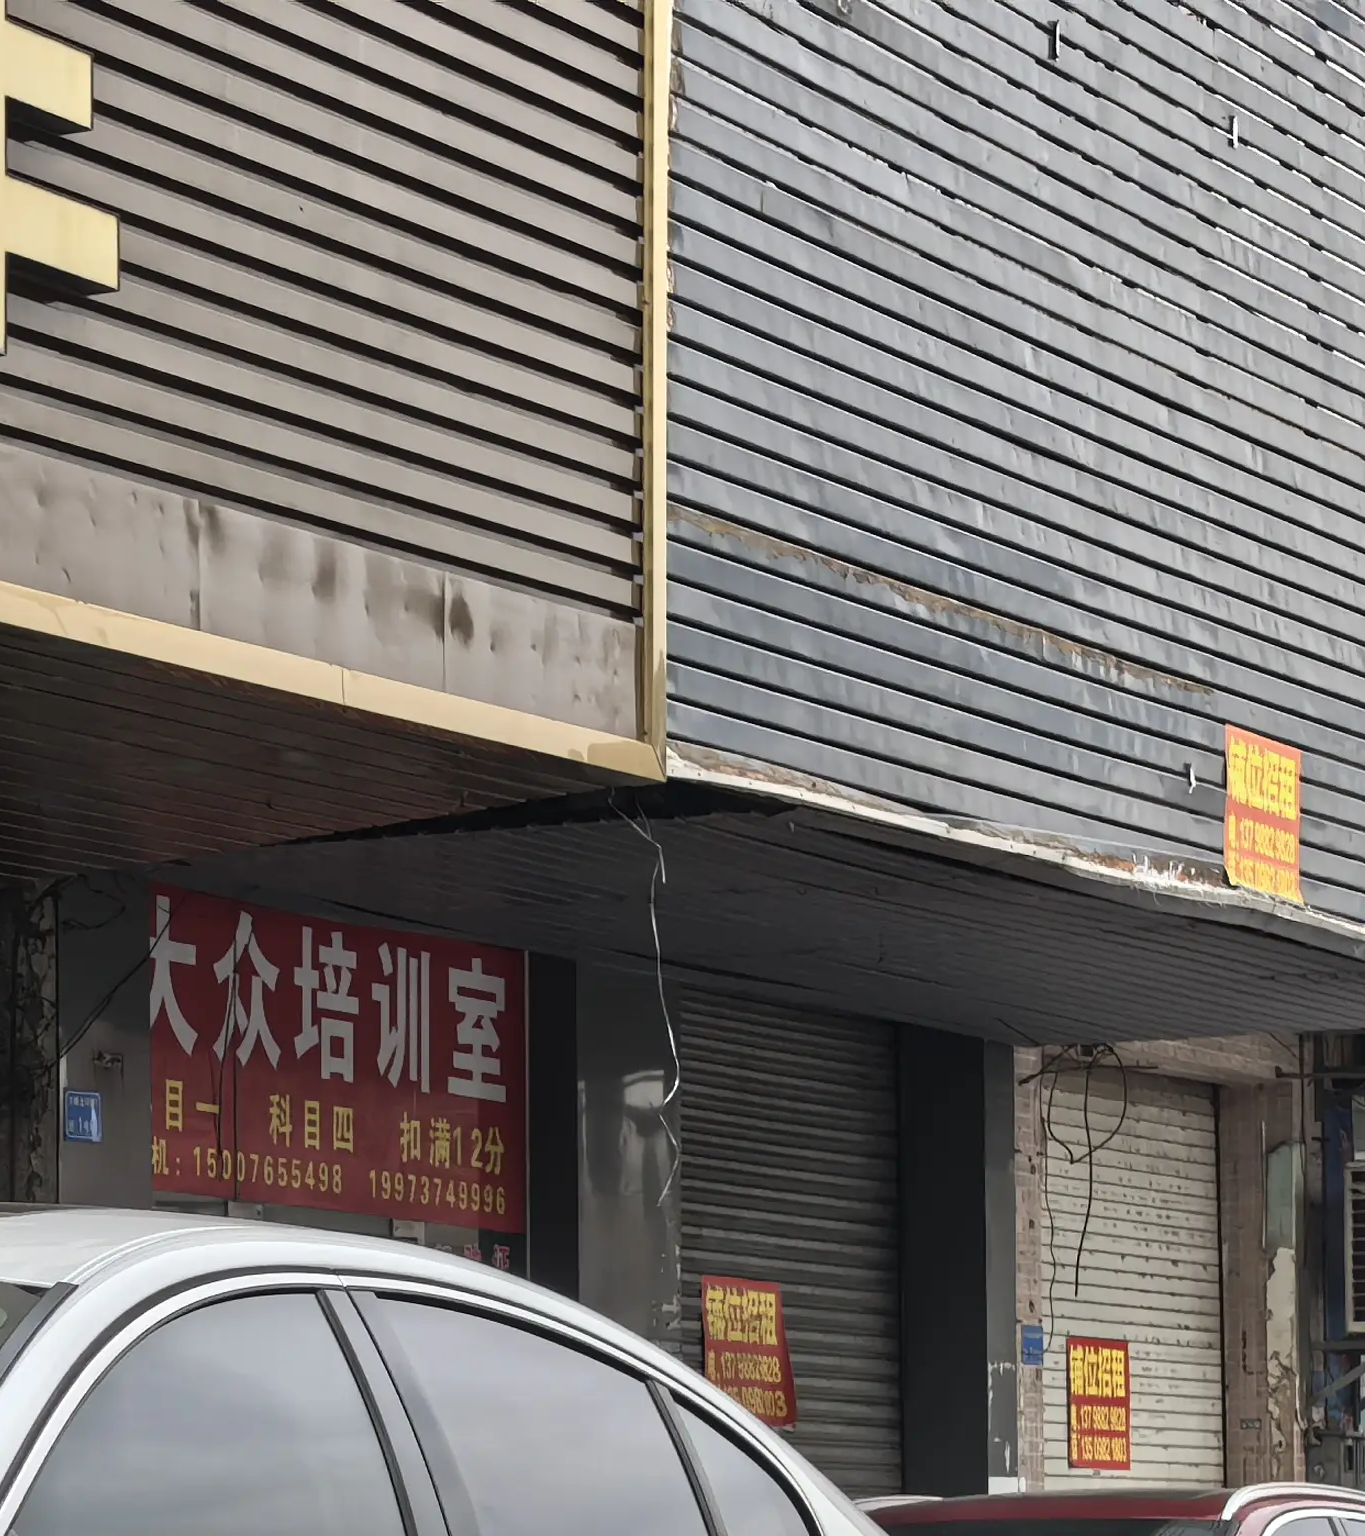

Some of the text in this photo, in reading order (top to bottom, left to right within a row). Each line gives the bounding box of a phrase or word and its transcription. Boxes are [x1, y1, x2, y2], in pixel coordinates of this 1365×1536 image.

[150, 895, 507, 1103] 大众培训室
[269, 1094, 355, 1154] 科目四
